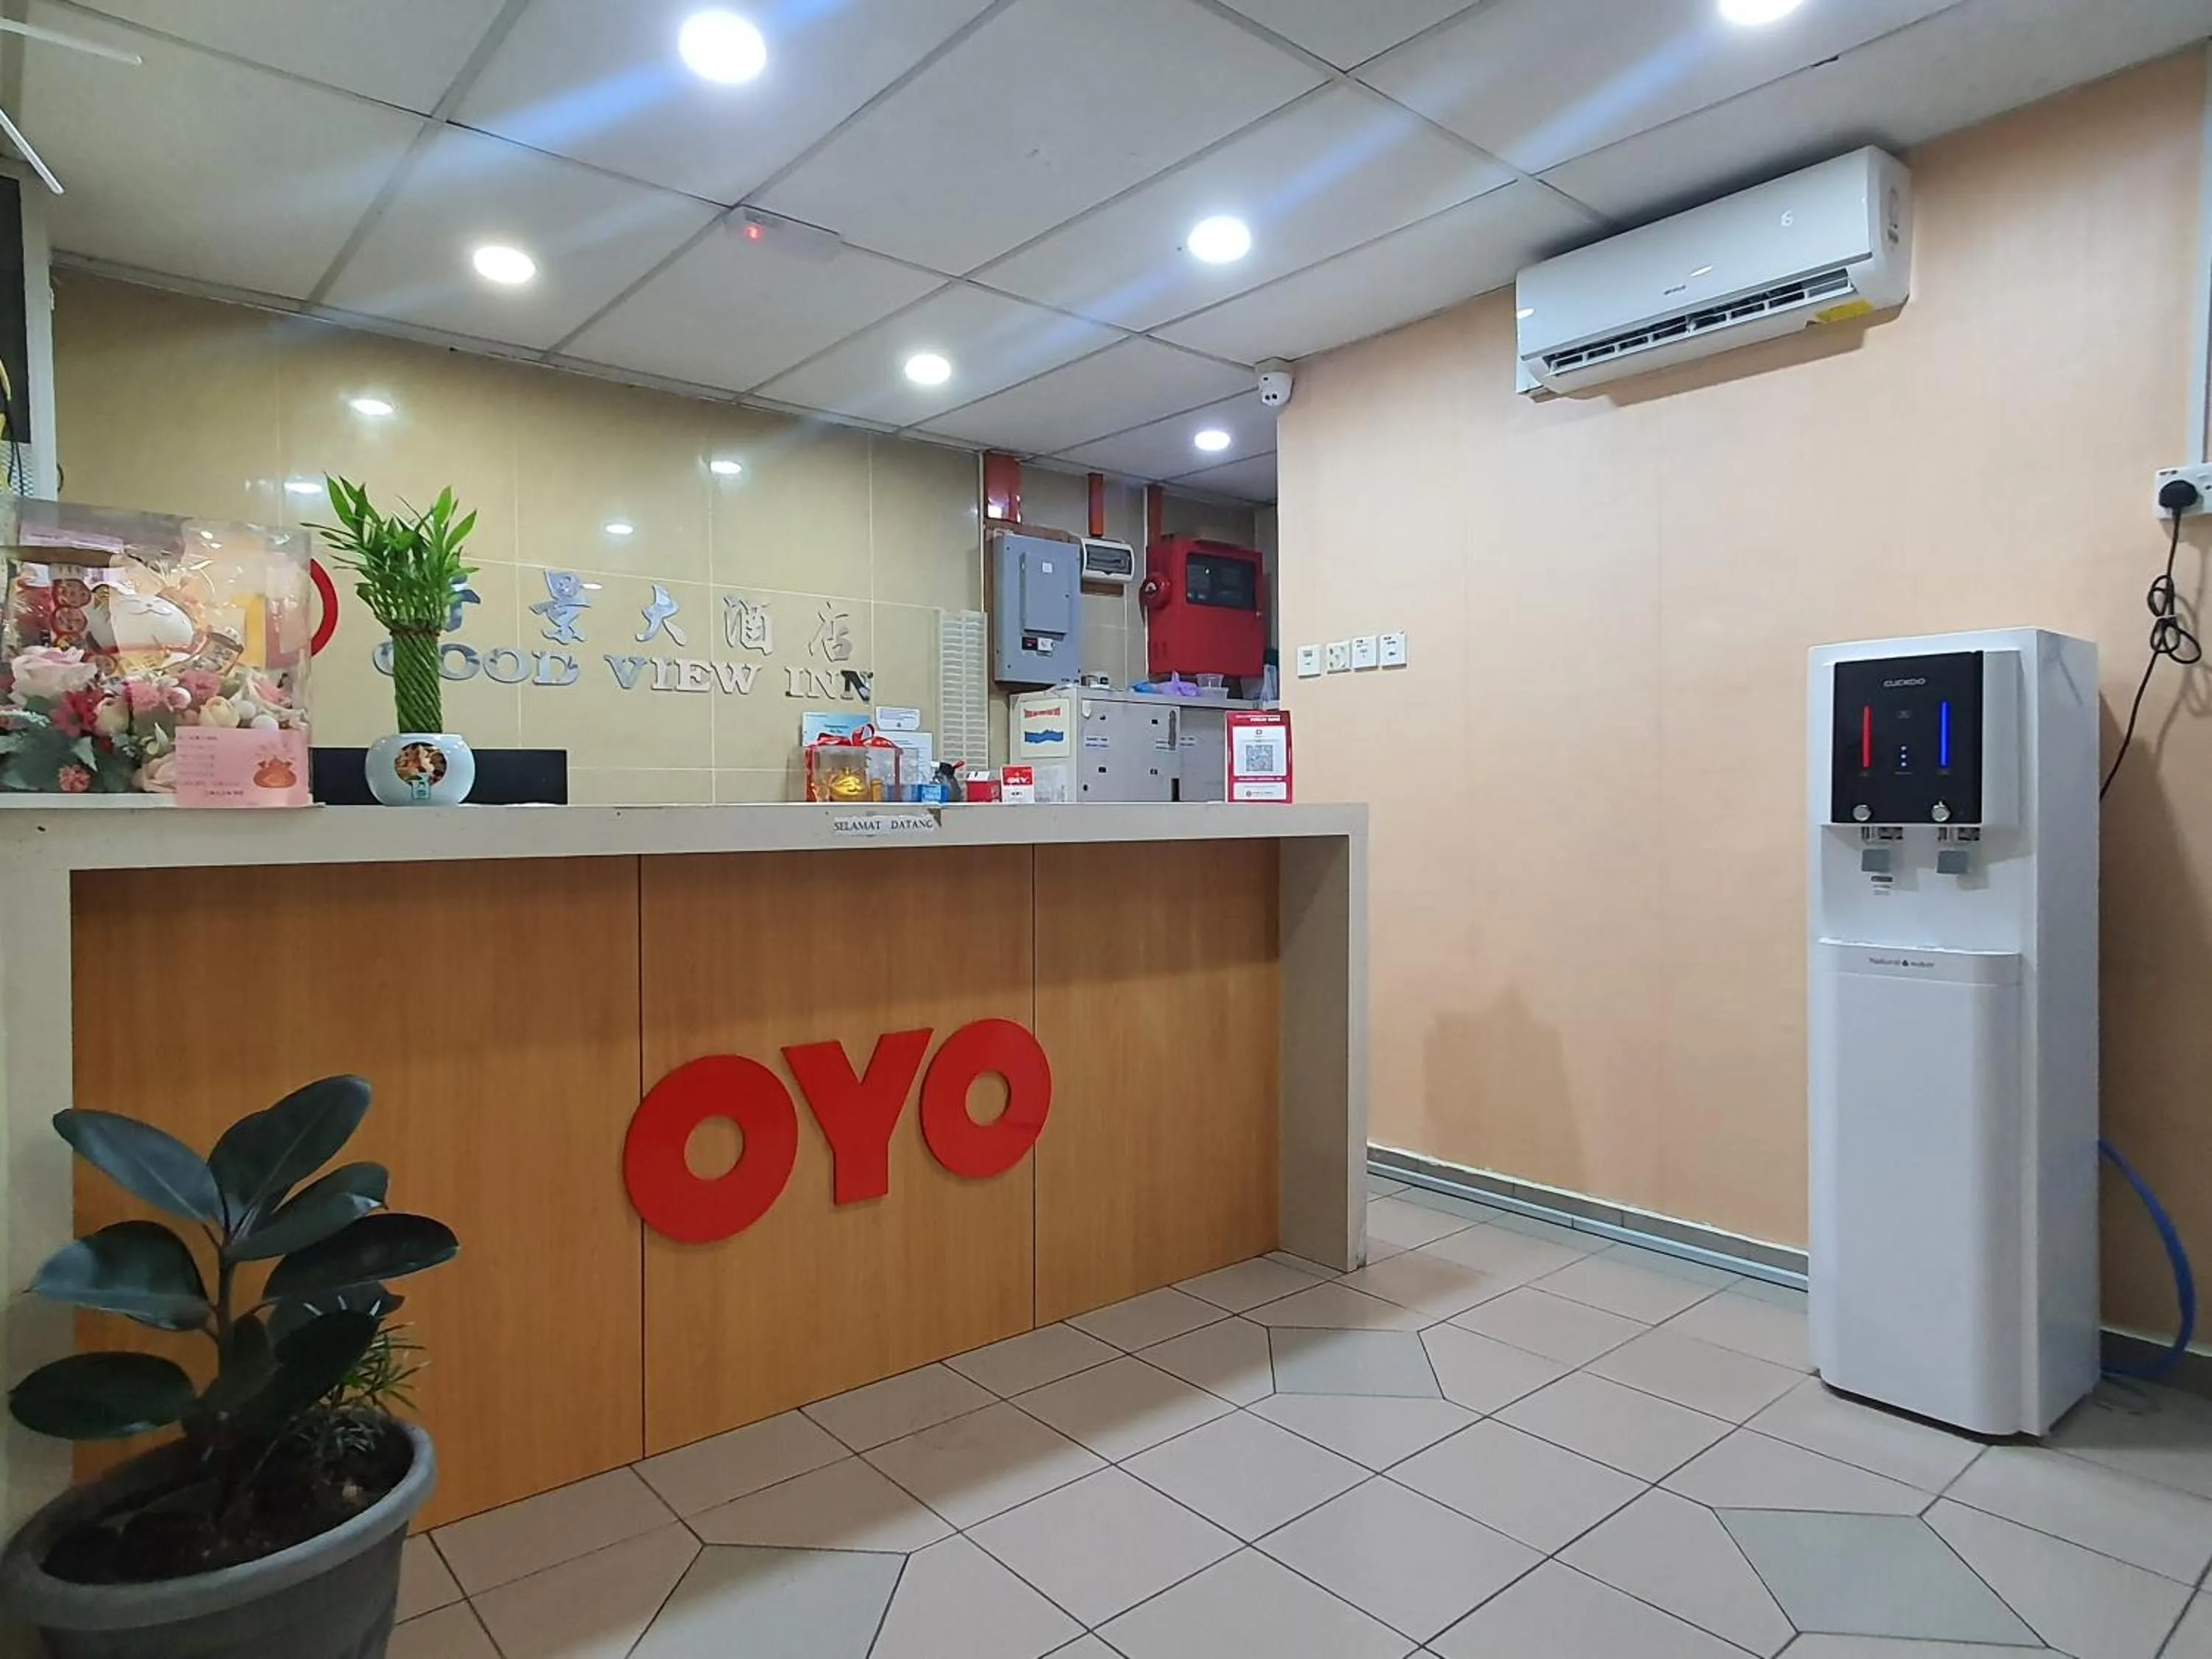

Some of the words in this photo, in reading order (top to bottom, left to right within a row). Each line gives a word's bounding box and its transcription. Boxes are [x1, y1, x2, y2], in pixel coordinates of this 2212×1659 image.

[603, 653, 763, 695] VIEW
[784, 665, 874, 703] INN
[833, 820, 882, 831] SELAMAT
[890, 818, 933, 830] DATANG
[624, 1018, 1051, 1245] OYO
